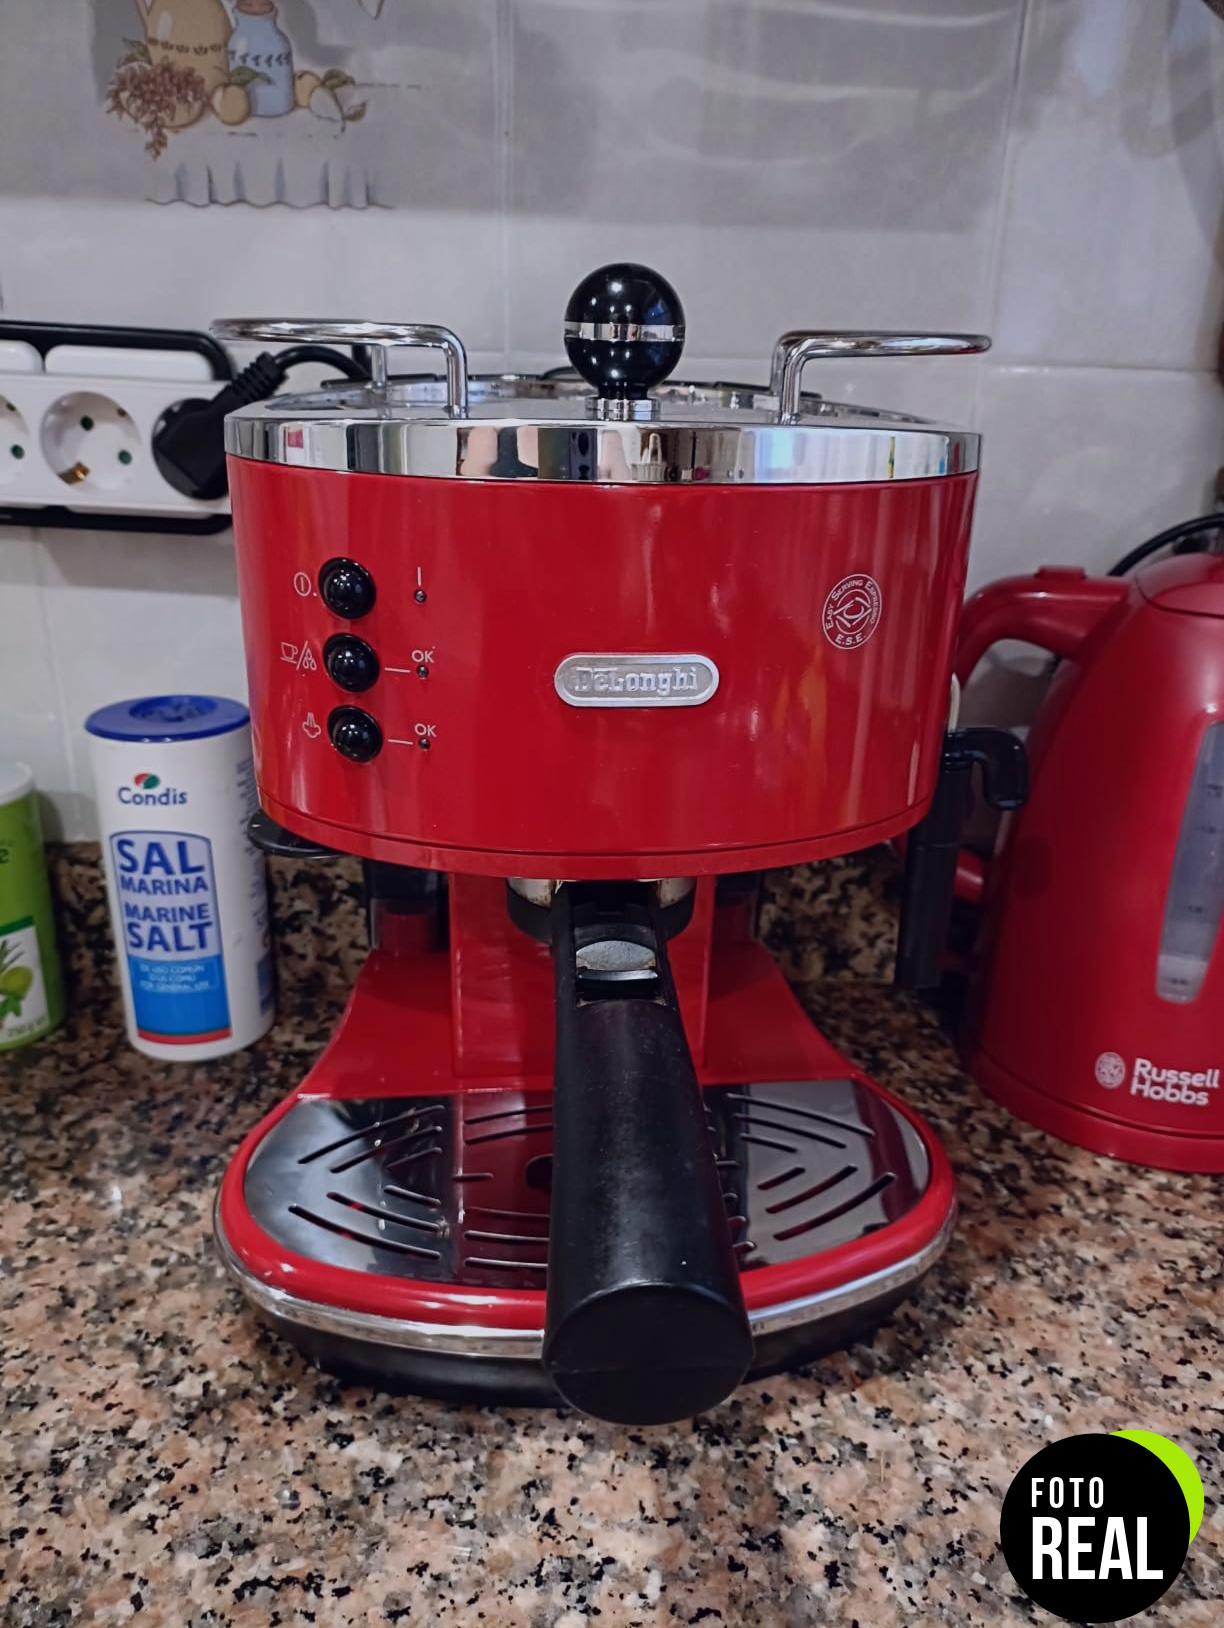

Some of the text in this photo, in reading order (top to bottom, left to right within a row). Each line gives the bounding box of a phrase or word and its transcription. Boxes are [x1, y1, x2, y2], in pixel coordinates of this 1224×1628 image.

[411, 650, 434, 664] OK
[414, 723, 437, 737] OK
[118, 786, 188, 806] Condis
[117, 838, 205, 875] SAL
[121, 875, 209, 895] MARINA
[124, 901, 210, 922] MARINE
[127, 921, 213, 952] SALT
[1134, 1057, 1220, 1089] Russell
[1130, 1076, 1209, 1106] Hobbs
